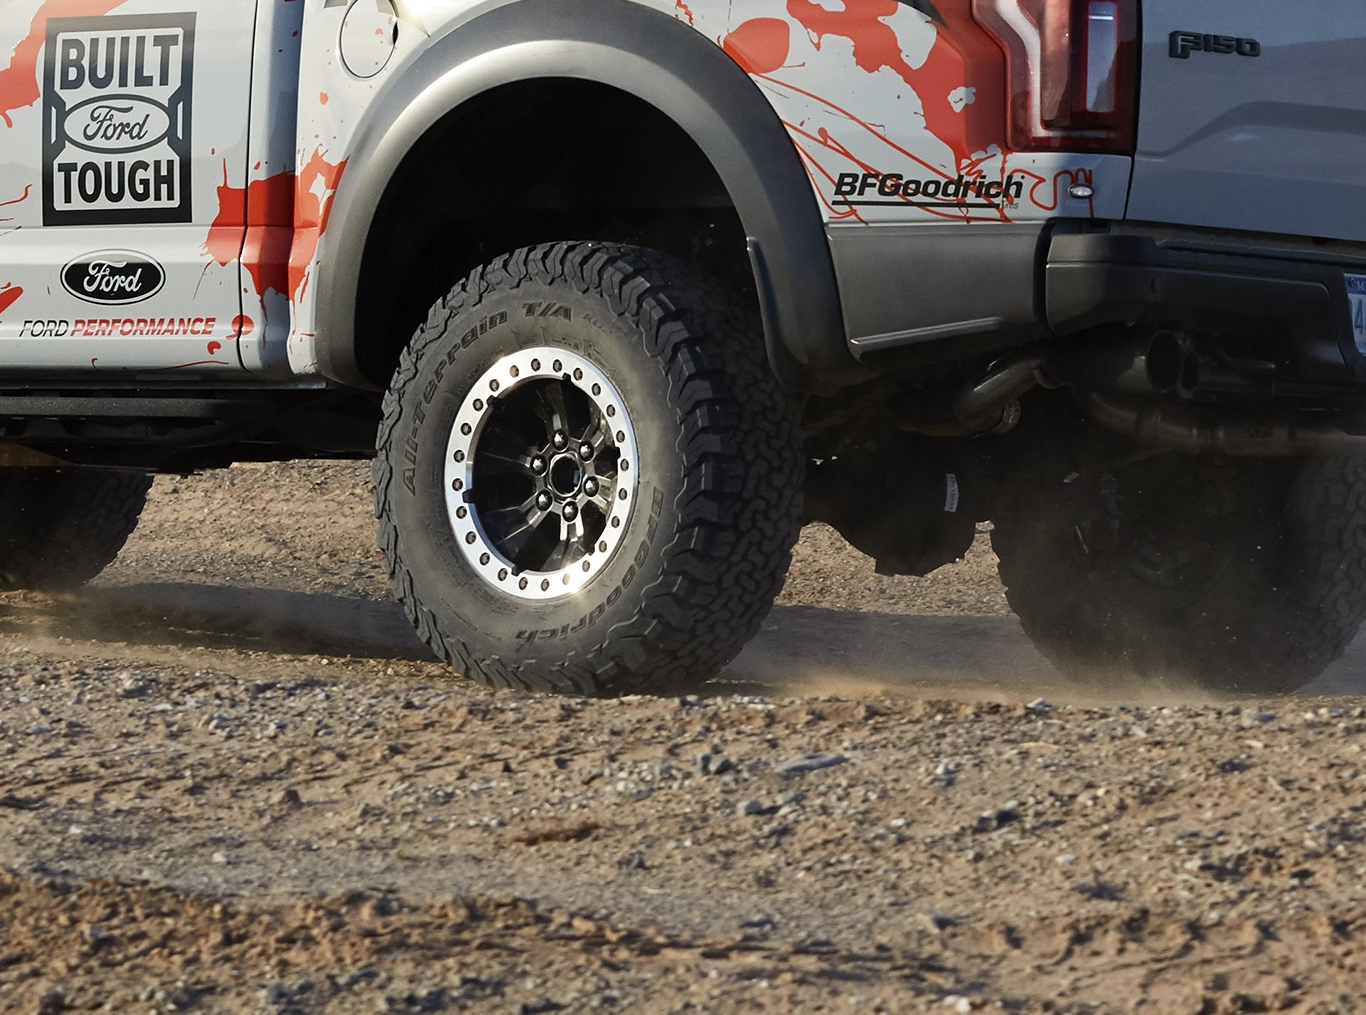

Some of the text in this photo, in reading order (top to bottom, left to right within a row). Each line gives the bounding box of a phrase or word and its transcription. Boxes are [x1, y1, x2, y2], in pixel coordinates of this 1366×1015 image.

[1169, 30, 1260, 59] F150
[59, 34, 179, 90] BUILT
[82, 105, 150, 141] Ford
[58, 159, 175, 204] TOUGH
[834, 173, 1023, 199] BFGoodrich
[82, 259, 143, 293] Ford
[19, 317, 217, 338] FORD PERFORMANCE
